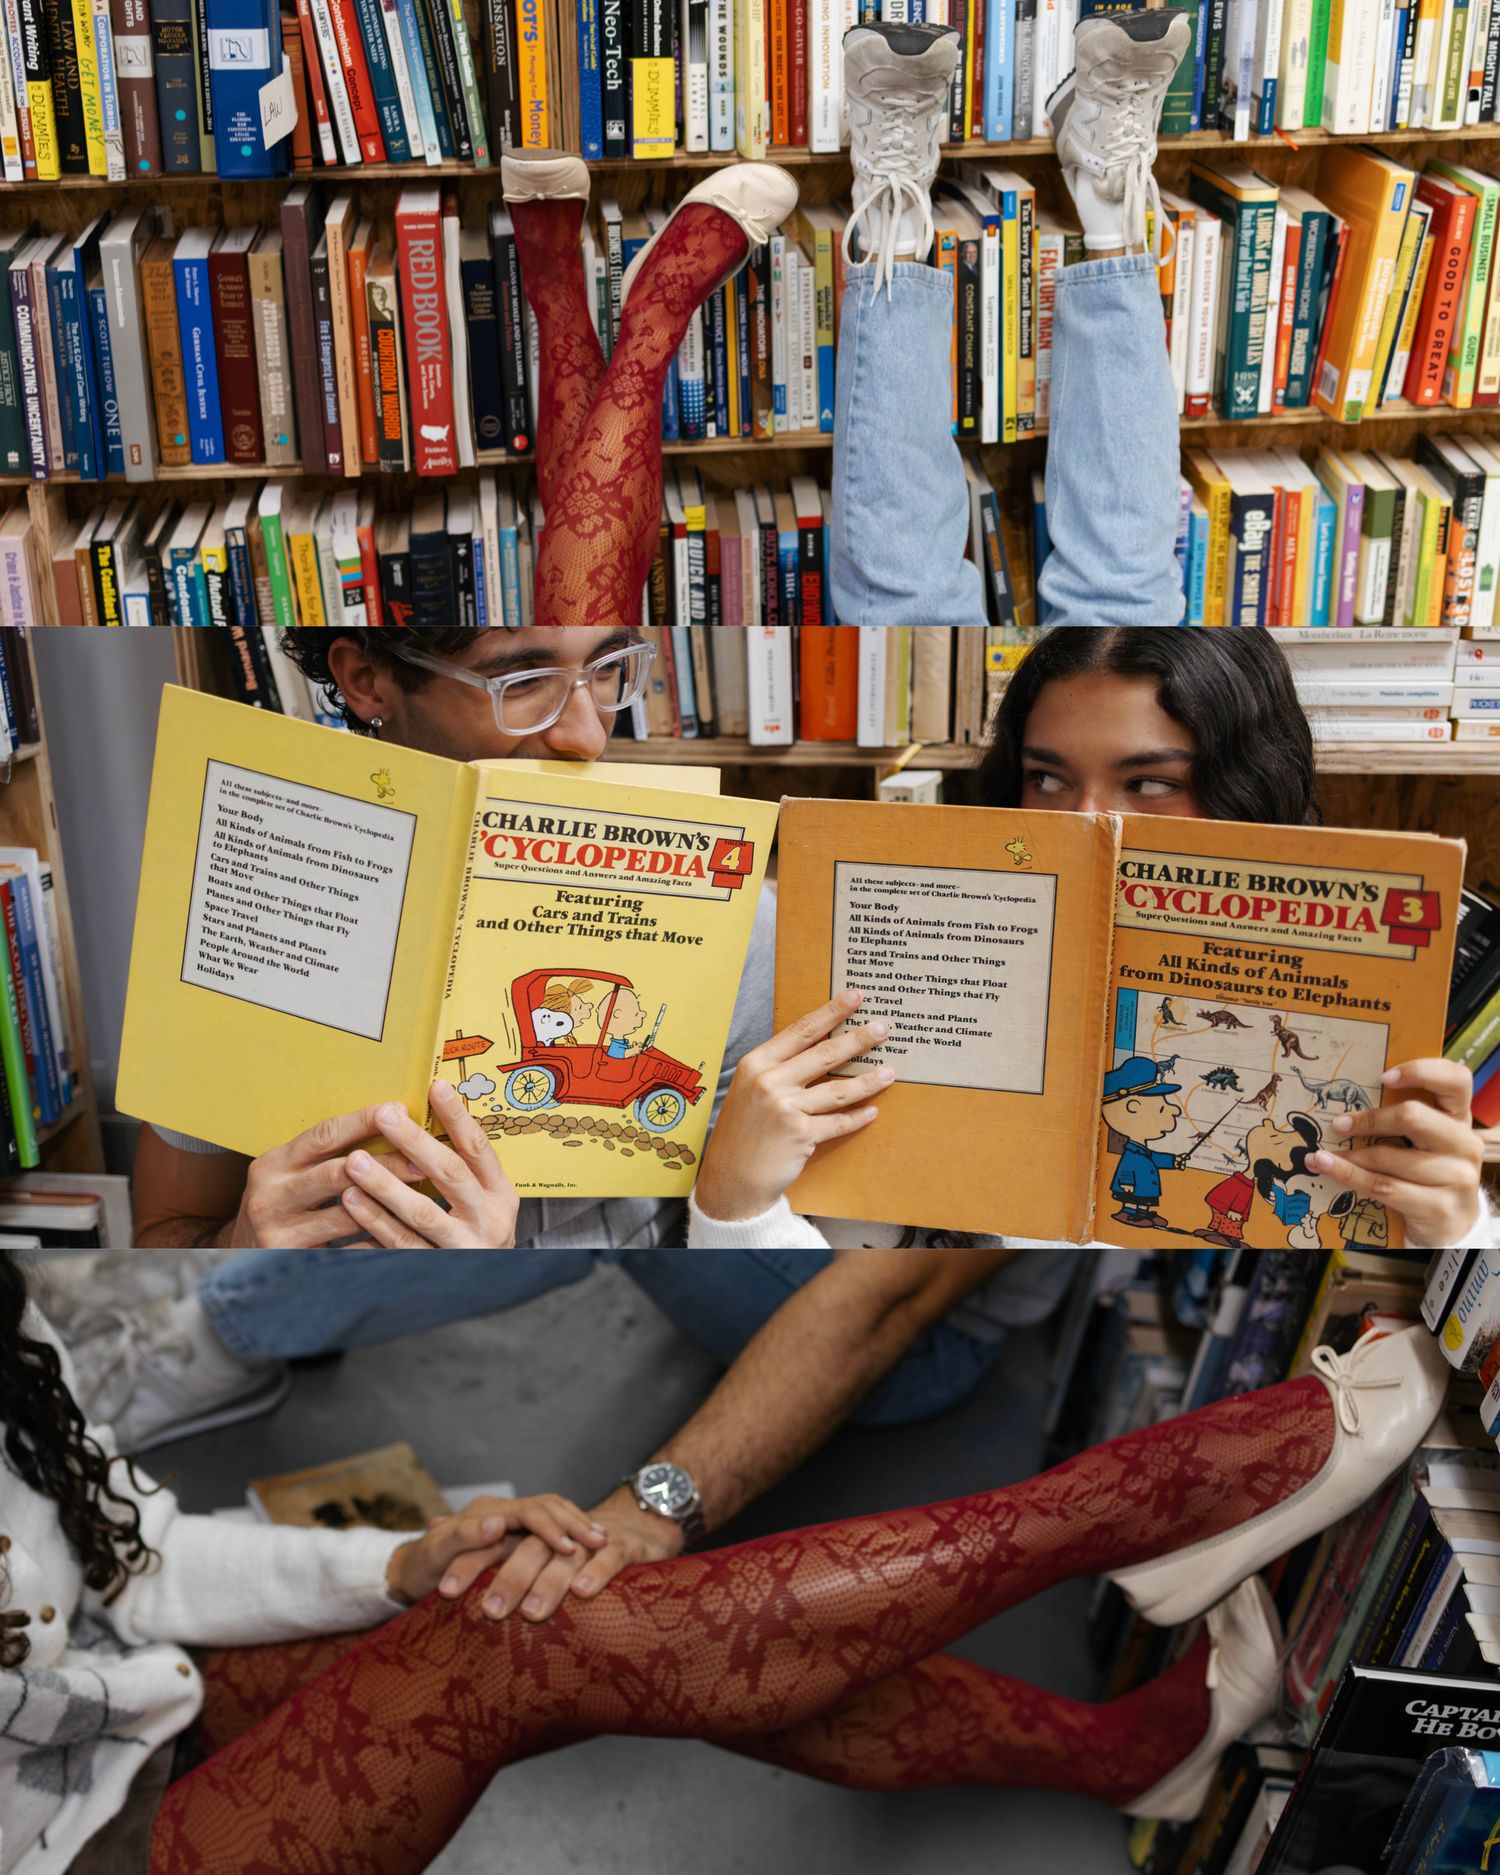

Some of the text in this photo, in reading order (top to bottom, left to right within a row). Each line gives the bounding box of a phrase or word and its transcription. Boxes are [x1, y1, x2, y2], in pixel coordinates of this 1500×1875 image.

[26, 24, 38, 70] Writing
[60, 20, 80, 90] LAW AND
[96, 16, 112, 80] CORPORATION
[604, 0, 622, 90] Neo-Tech
[718, 25, 727, 78] WOUNDS
[822, 25, 830, 90] INNOVATION
[1485, 40, 1498, 82] MIGHTY
[12, 37, 25, 100] ACCOUNTABLE
[55, 58, 69, 117] HEALTH
[347, 68, 363, 112] Concept
[80, 58, 105, 145] GET MONEY
[103, 95, 115, 131] FLORIDA
[263, 101, 283, 127] LAW
[648, 70, 661, 135] DUMMIES
[1481, 84, 1494, 111] FALL
[31, 94, 51, 161] DUMMIES
[529, 100, 544, 149] Money
[608, 225, 620, 264] BUSINESS
[1475, 197, 1495, 283] SMALL BUSINESS
[408, 238, 443, 363] RED BOOK
[610, 266, 621, 299] LETTERS
[755, 285, 766, 302] THE
[1020, 203, 1031, 355] Tax Savvy for Small Business
[802, 272, 812, 352] STRENGTHSFINDER
[965, 283, 975, 369] CONSTANT CHANGE
[1198, 236, 1213, 379] NOW DISCOVER YOUR STRENGTHS
[1427, 247, 1461, 382] GOOD TO GREAT
[1039, 317, 1052, 350] MAN
[1464, 335, 1477, 366] GUIDE
[16, 305, 45, 466] COMMUNICATING UNCERTAINTY
[100, 320, 121, 452] SCOTT TUROW ONE L
[192, 327, 207, 420] GERMAN CIVIL JUSTICE
[377, 328, 401, 440] COURTROOM WARRIOR
[757, 361, 767, 379] DNA
[1238, 509, 1271, 551] eBay
[1286, 536, 1296, 562] MBA
[300, 543, 312, 572] Thank
[687, 538, 706, 619] QUICK AND
[98, 546, 117, 617] The Confident
[207, 575, 221, 619] Mutual
[303, 576, 314, 594] You
[652, 557, 666, 614] ANSWER
[217, 803, 263, 825] Your Body
[482, 811, 710, 851] CHARLIE BROWN'S
[215, 817, 393, 874] All Kinds of Animals from Fish to Frogs
[480, 830, 707, 879] 'CYCLOPEDIA
[721, 847, 741, 870] 4
[210, 863, 254, 880] that Move
[210, 852, 359, 902] Cars and Trains and Other Things
[494, 861, 520, 870] Super
[520, 864, 563, 874] Questions
[581, 870, 617, 879] Answers
[635, 875, 671, 886] Amazing
[672, 878, 692, 887] Facts
[1119, 861, 1379, 902] CHARLIE BROWN'S
[532, 905, 657, 927] Cars and Trains
[555, 890, 644, 912] Featuring
[1119, 878, 1380, 932] 'CYCLOPEDIA
[1398, 897, 1423, 923] 3
[475, 918, 703, 945] and Other Things that Move
[1135, 910, 1162, 920] Super
[1162, 914, 1208, 925] Questions
[1229, 921, 1269, 932] Answers
[1291, 928, 1335, 942] Amazing
[1337, 933, 1362, 943] Facts
[1158, 953, 1348, 989] All Kinds of Animals
[1202, 941, 1304, 969] Featuring
[846, 969, 873, 978] Boats
[894, 972, 923, 981] Other
[924, 974, 958, 985] Things
[960, 977, 980, 986] that
[982, 979, 1007, 988] Float
[1119, 964, 1391, 1012] from Dinosaurs to Elephants
[890, 1009, 925, 1019] Planets
[927, 1013, 945, 1021] and
[947, 1014, 977, 1023] Plants
[1411, 1718, 1454, 1736] HE
